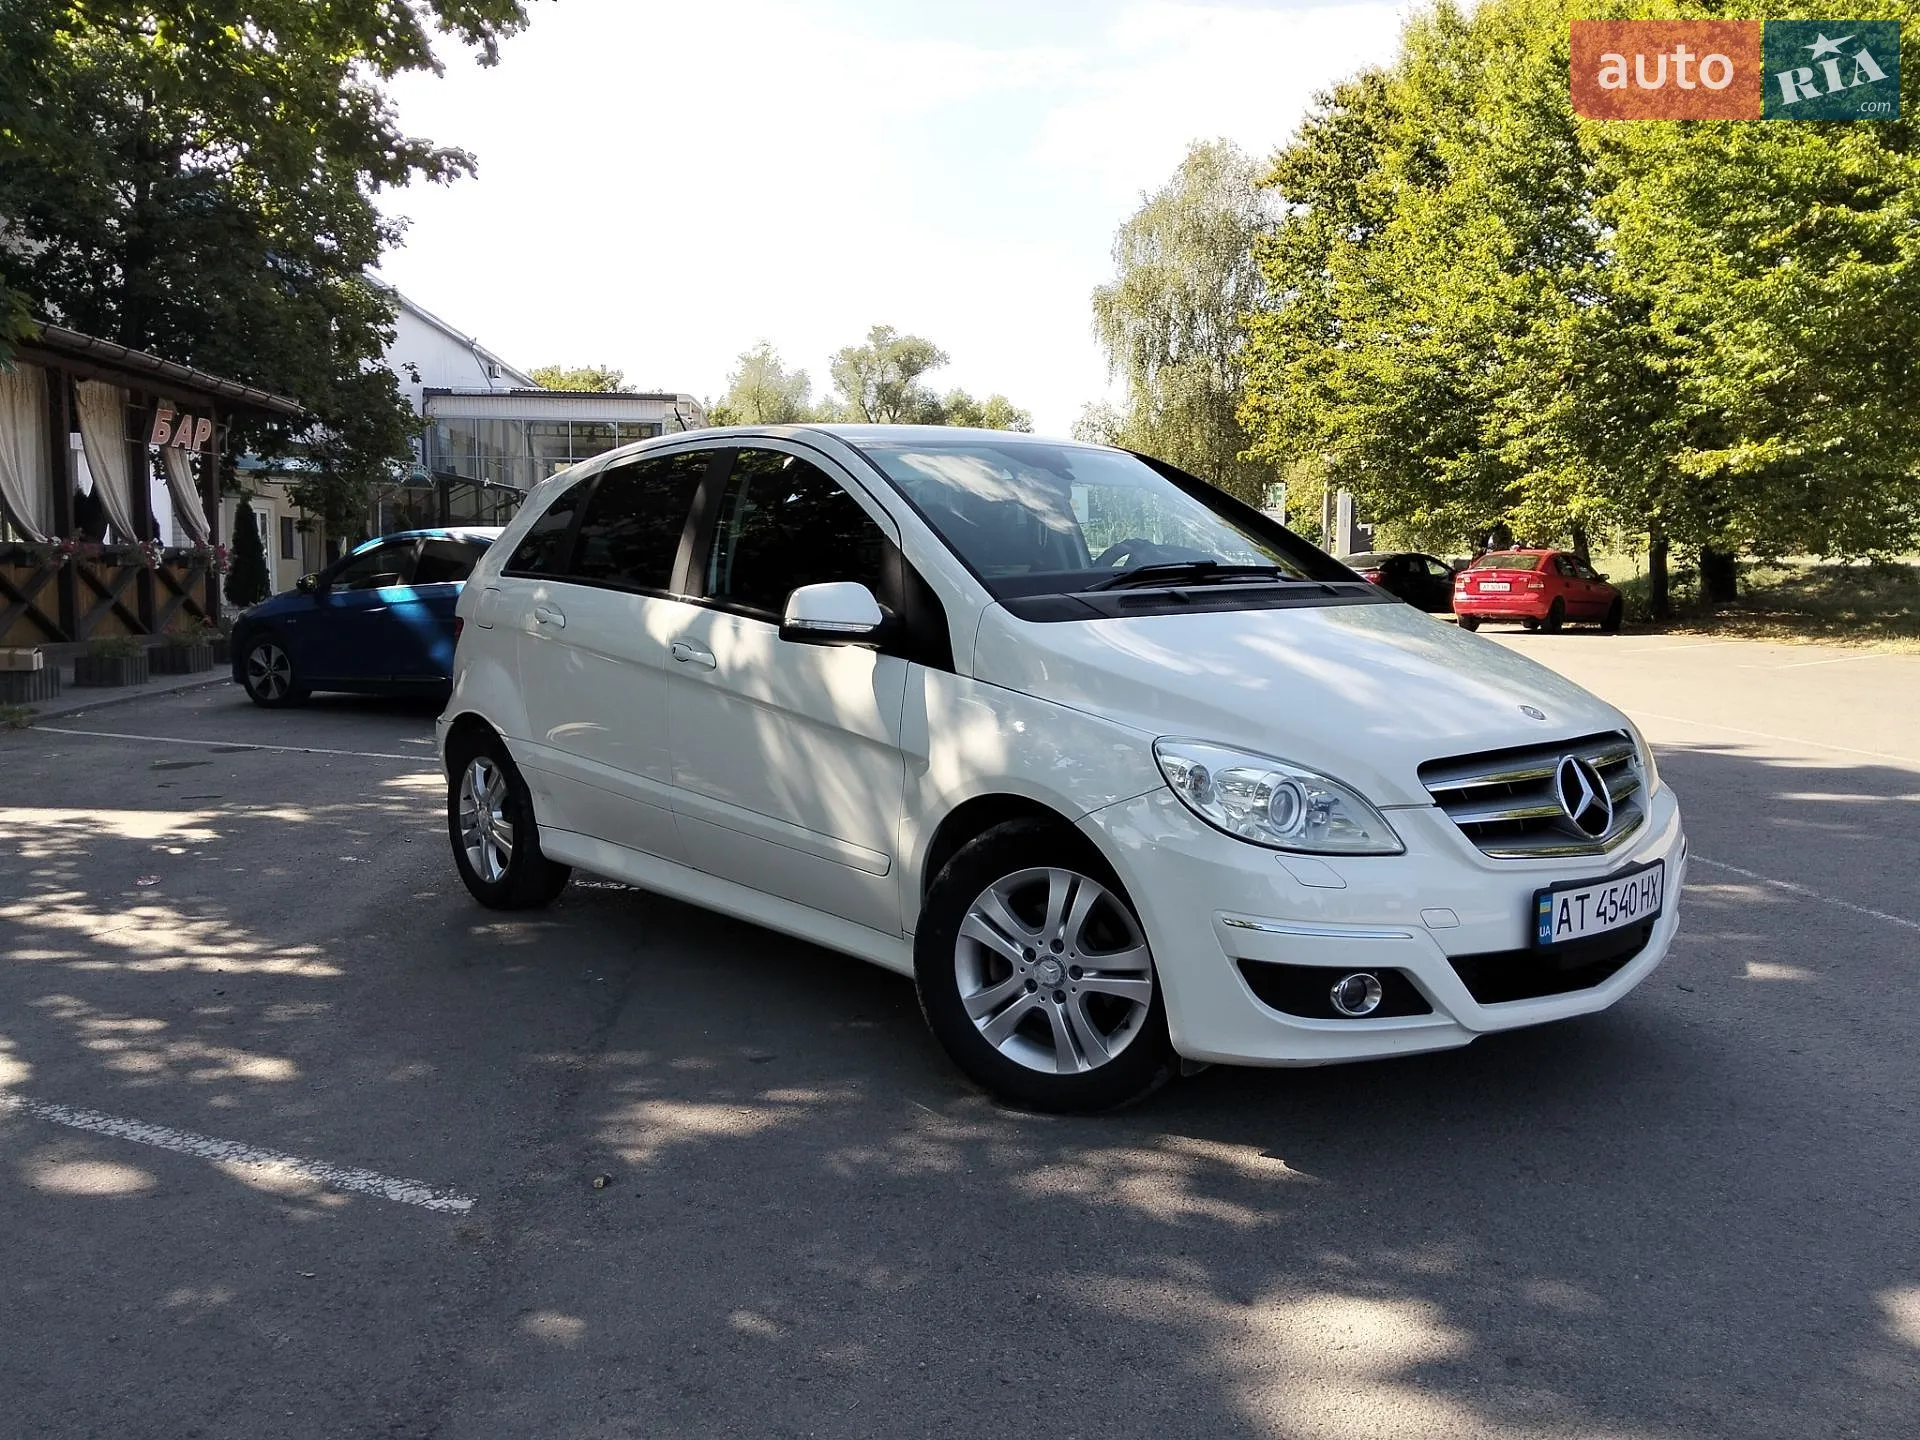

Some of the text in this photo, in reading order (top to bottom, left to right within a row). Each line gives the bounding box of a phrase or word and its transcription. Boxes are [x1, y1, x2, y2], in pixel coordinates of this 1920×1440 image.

[150, 408, 212, 451] БАР
[1556, 872, 1659, 935] AT 4540 HX
[1539, 925, 1552, 937] UA
